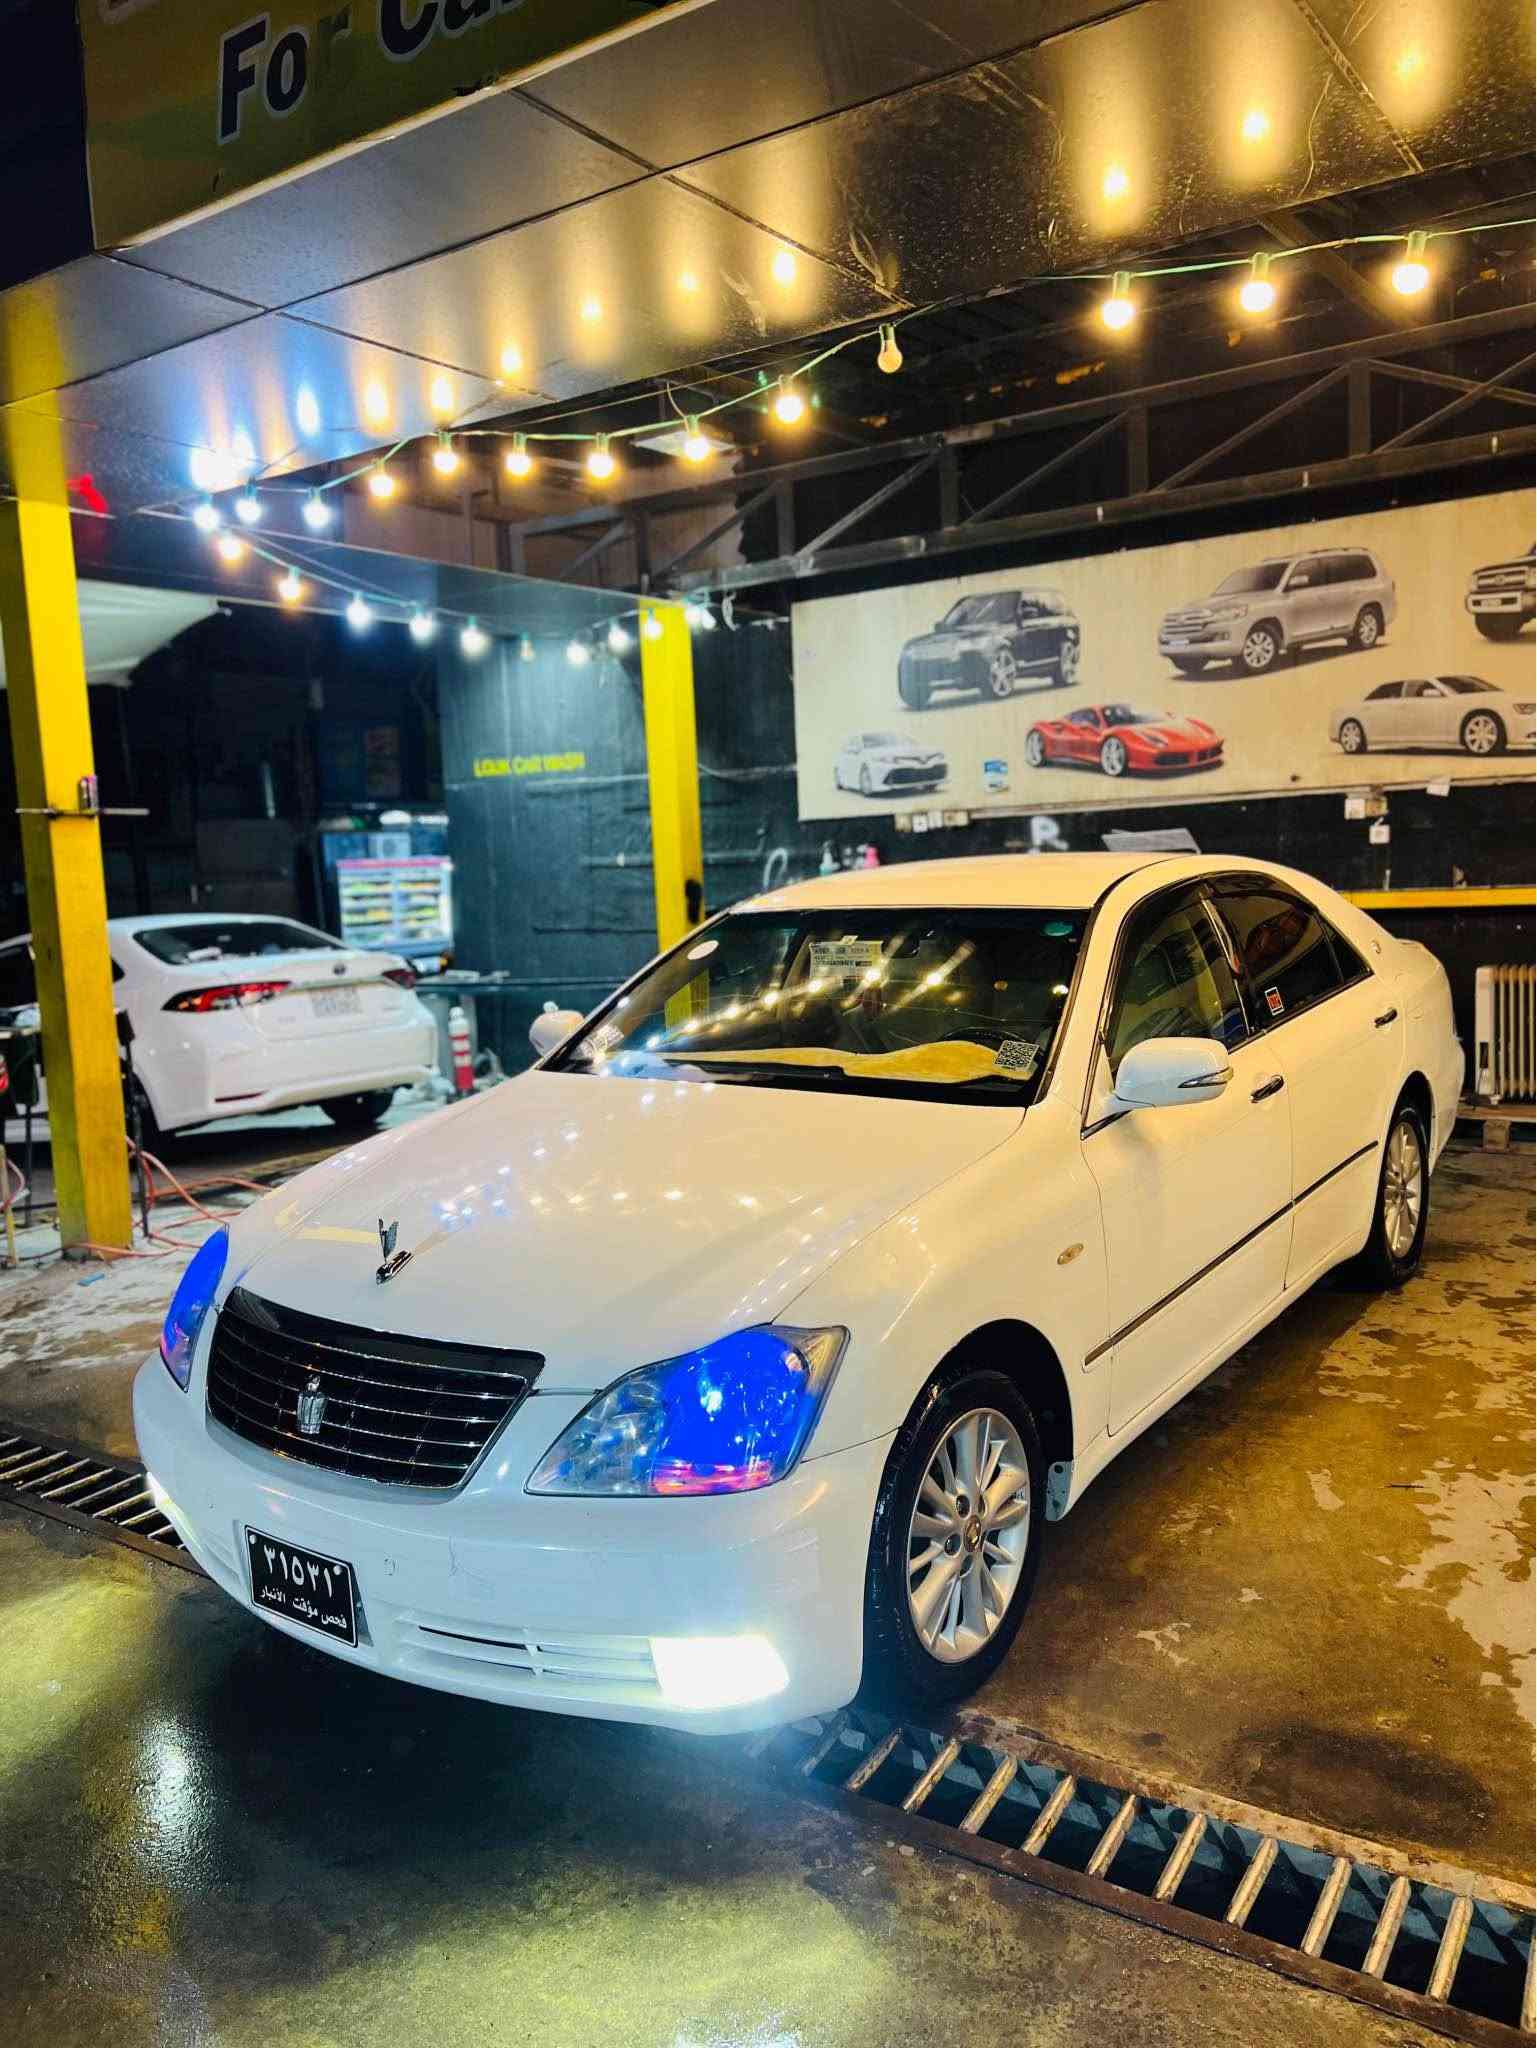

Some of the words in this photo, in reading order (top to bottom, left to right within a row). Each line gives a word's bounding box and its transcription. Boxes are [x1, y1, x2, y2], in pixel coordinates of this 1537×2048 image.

[217, 14, 350, 143] Fo
[263, 1544, 332, 1598] ٣١٥٣١
[321, 1613, 347, 1628] فحص
